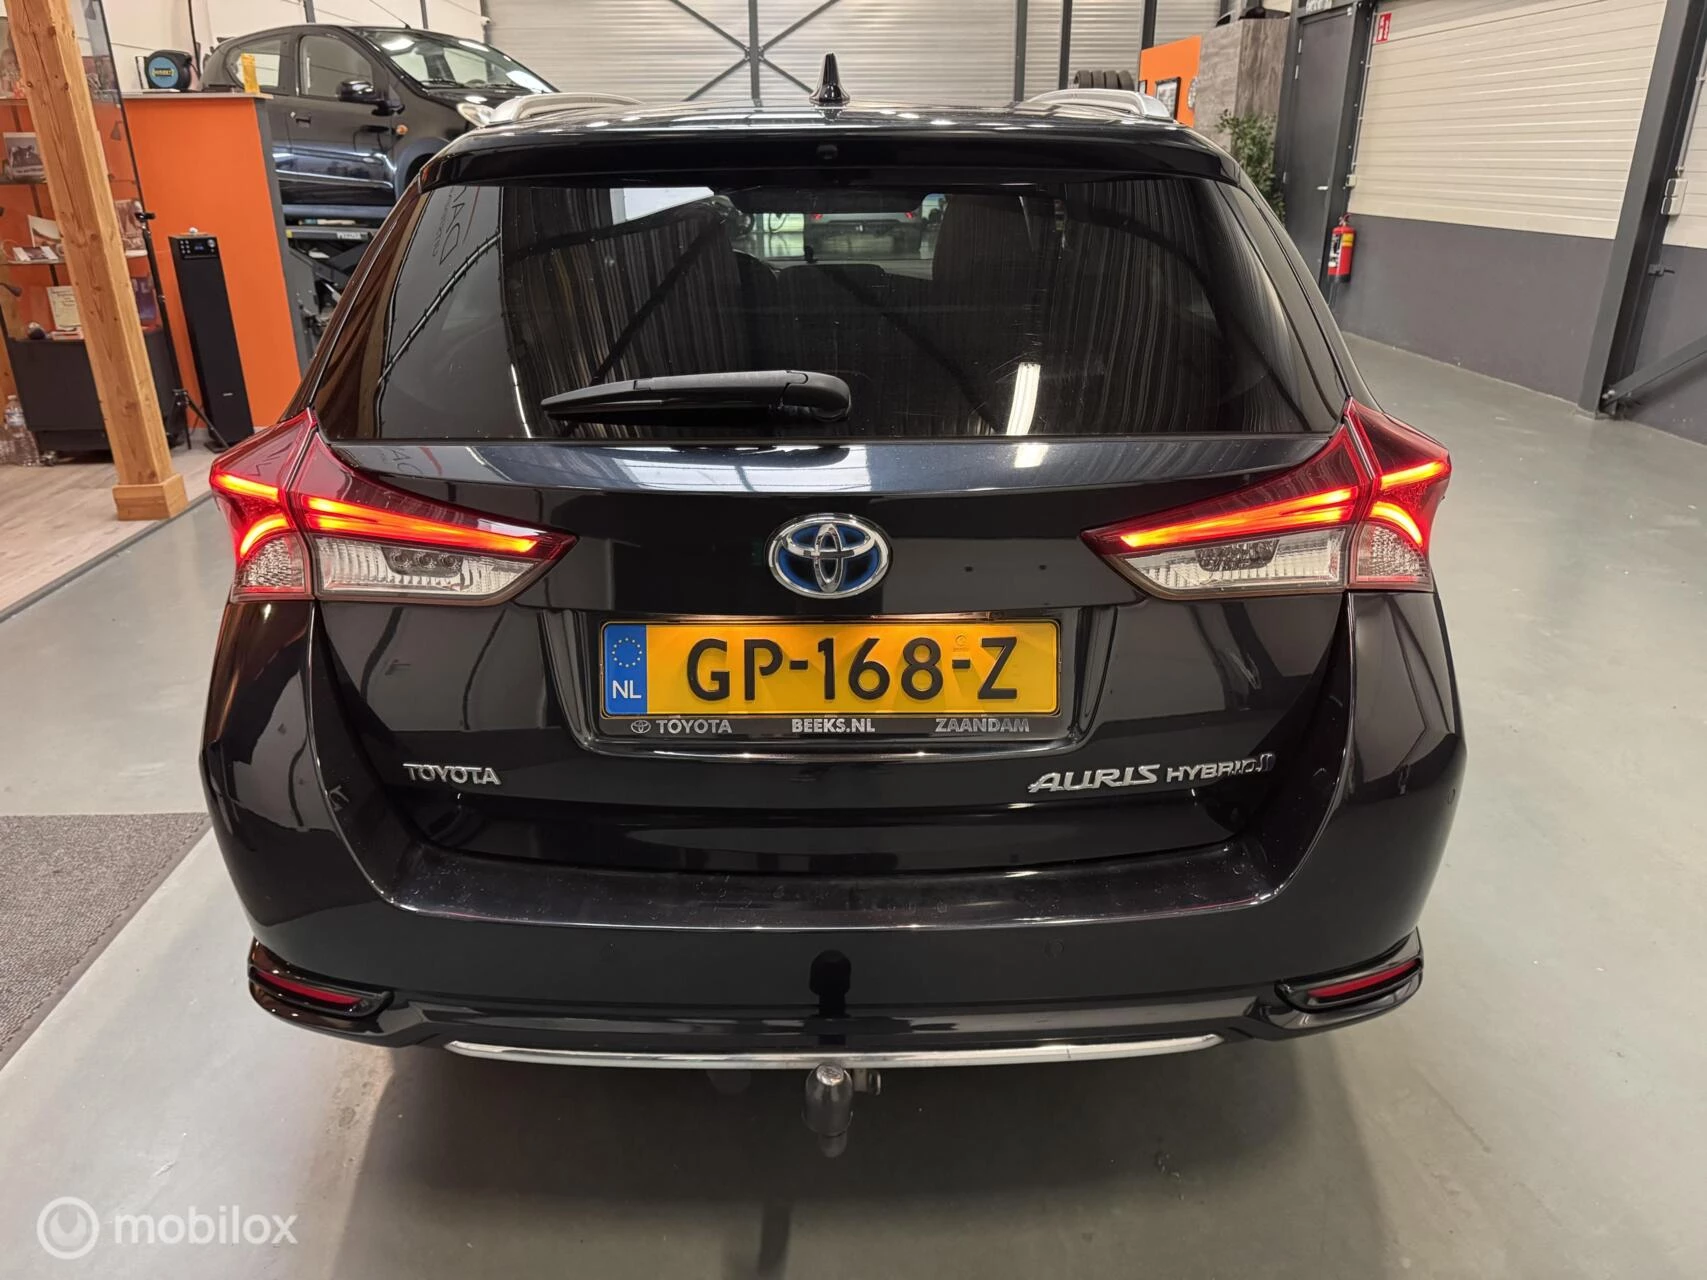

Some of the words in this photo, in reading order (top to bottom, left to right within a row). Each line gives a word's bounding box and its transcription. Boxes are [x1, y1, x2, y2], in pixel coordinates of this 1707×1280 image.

[686, 637, 1018, 701] GP-168-Z
[612, 680, 642, 699] NL
[656, 719, 733, 734] TOYOTA
[791, 718, 875, 733] BEEKS.NL
[935, 718, 1030, 733] ZAANDAM
[402, 763, 502, 785] TOYOTA
[1028, 763, 1161, 793] AURIS
